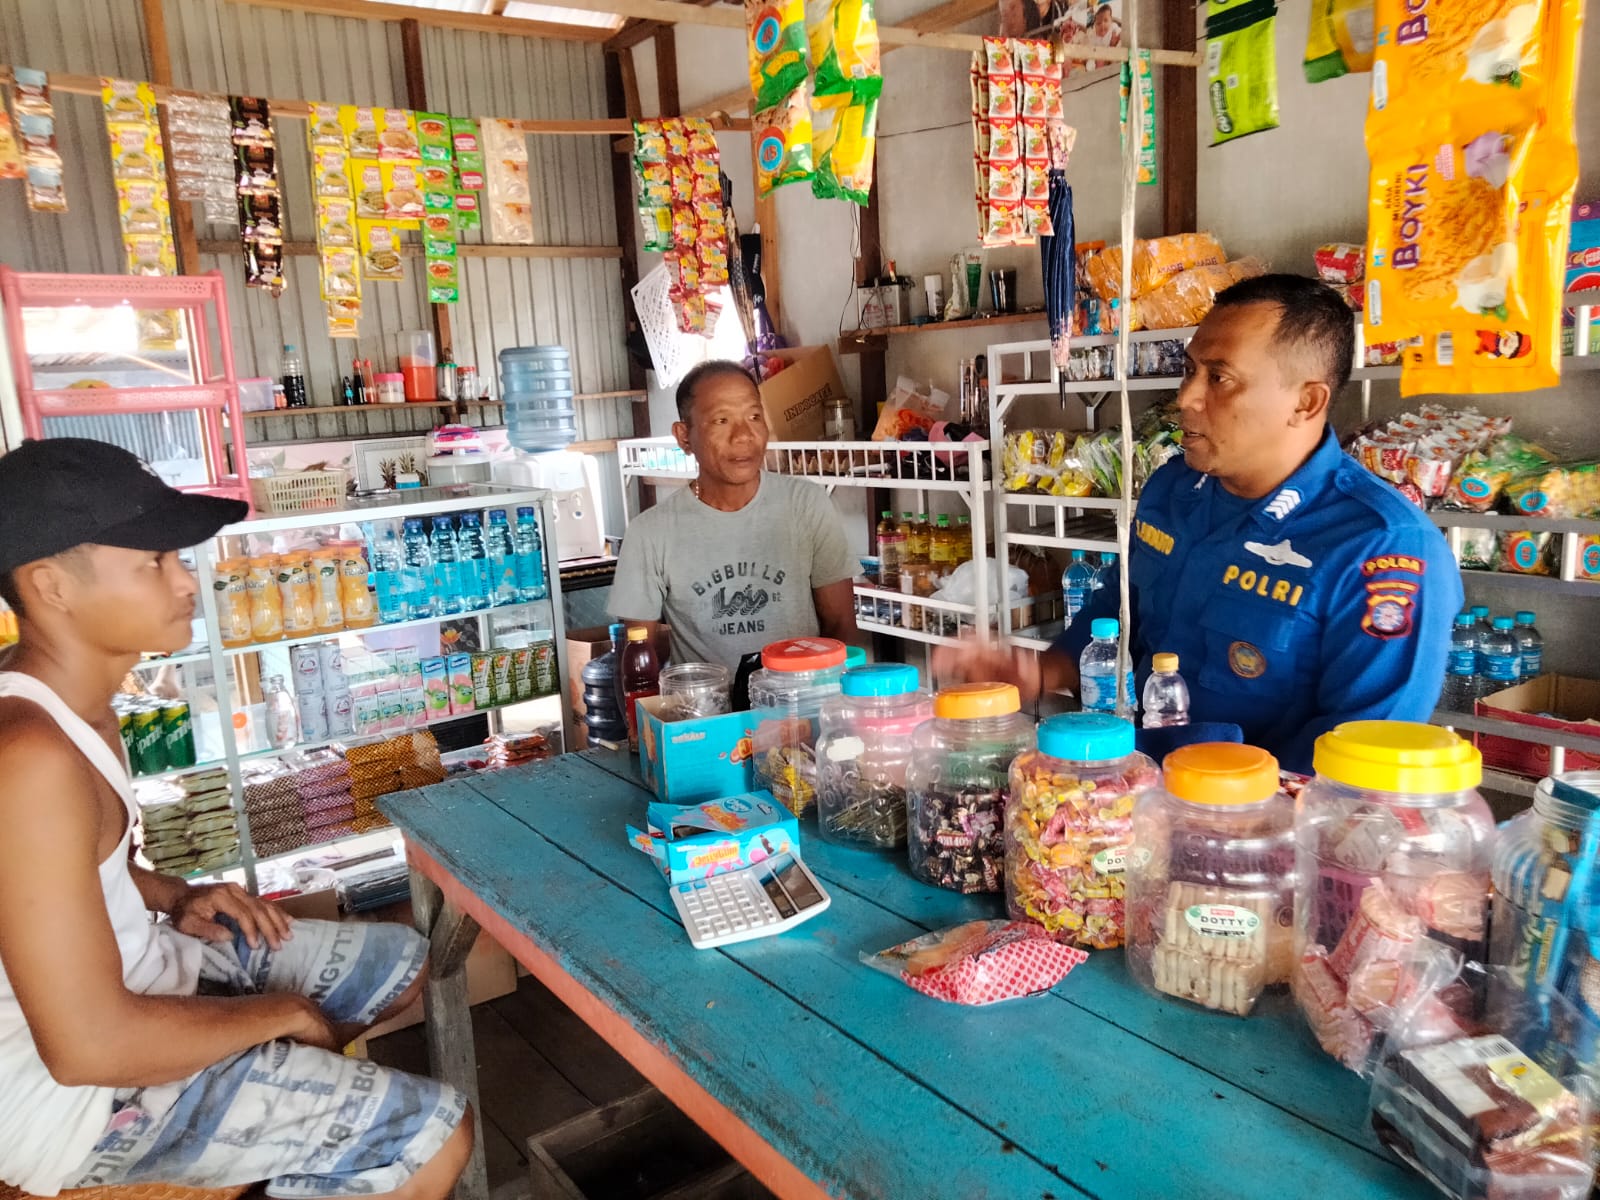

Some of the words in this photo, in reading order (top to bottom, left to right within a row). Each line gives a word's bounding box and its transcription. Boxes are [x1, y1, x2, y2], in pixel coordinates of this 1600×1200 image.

[1392, 163, 1429, 270] BOYKI
[1223, 565, 1304, 607] POLRI
[719, 620, 765, 635] JEANS
[1201, 915, 1245, 927] DOTTY
